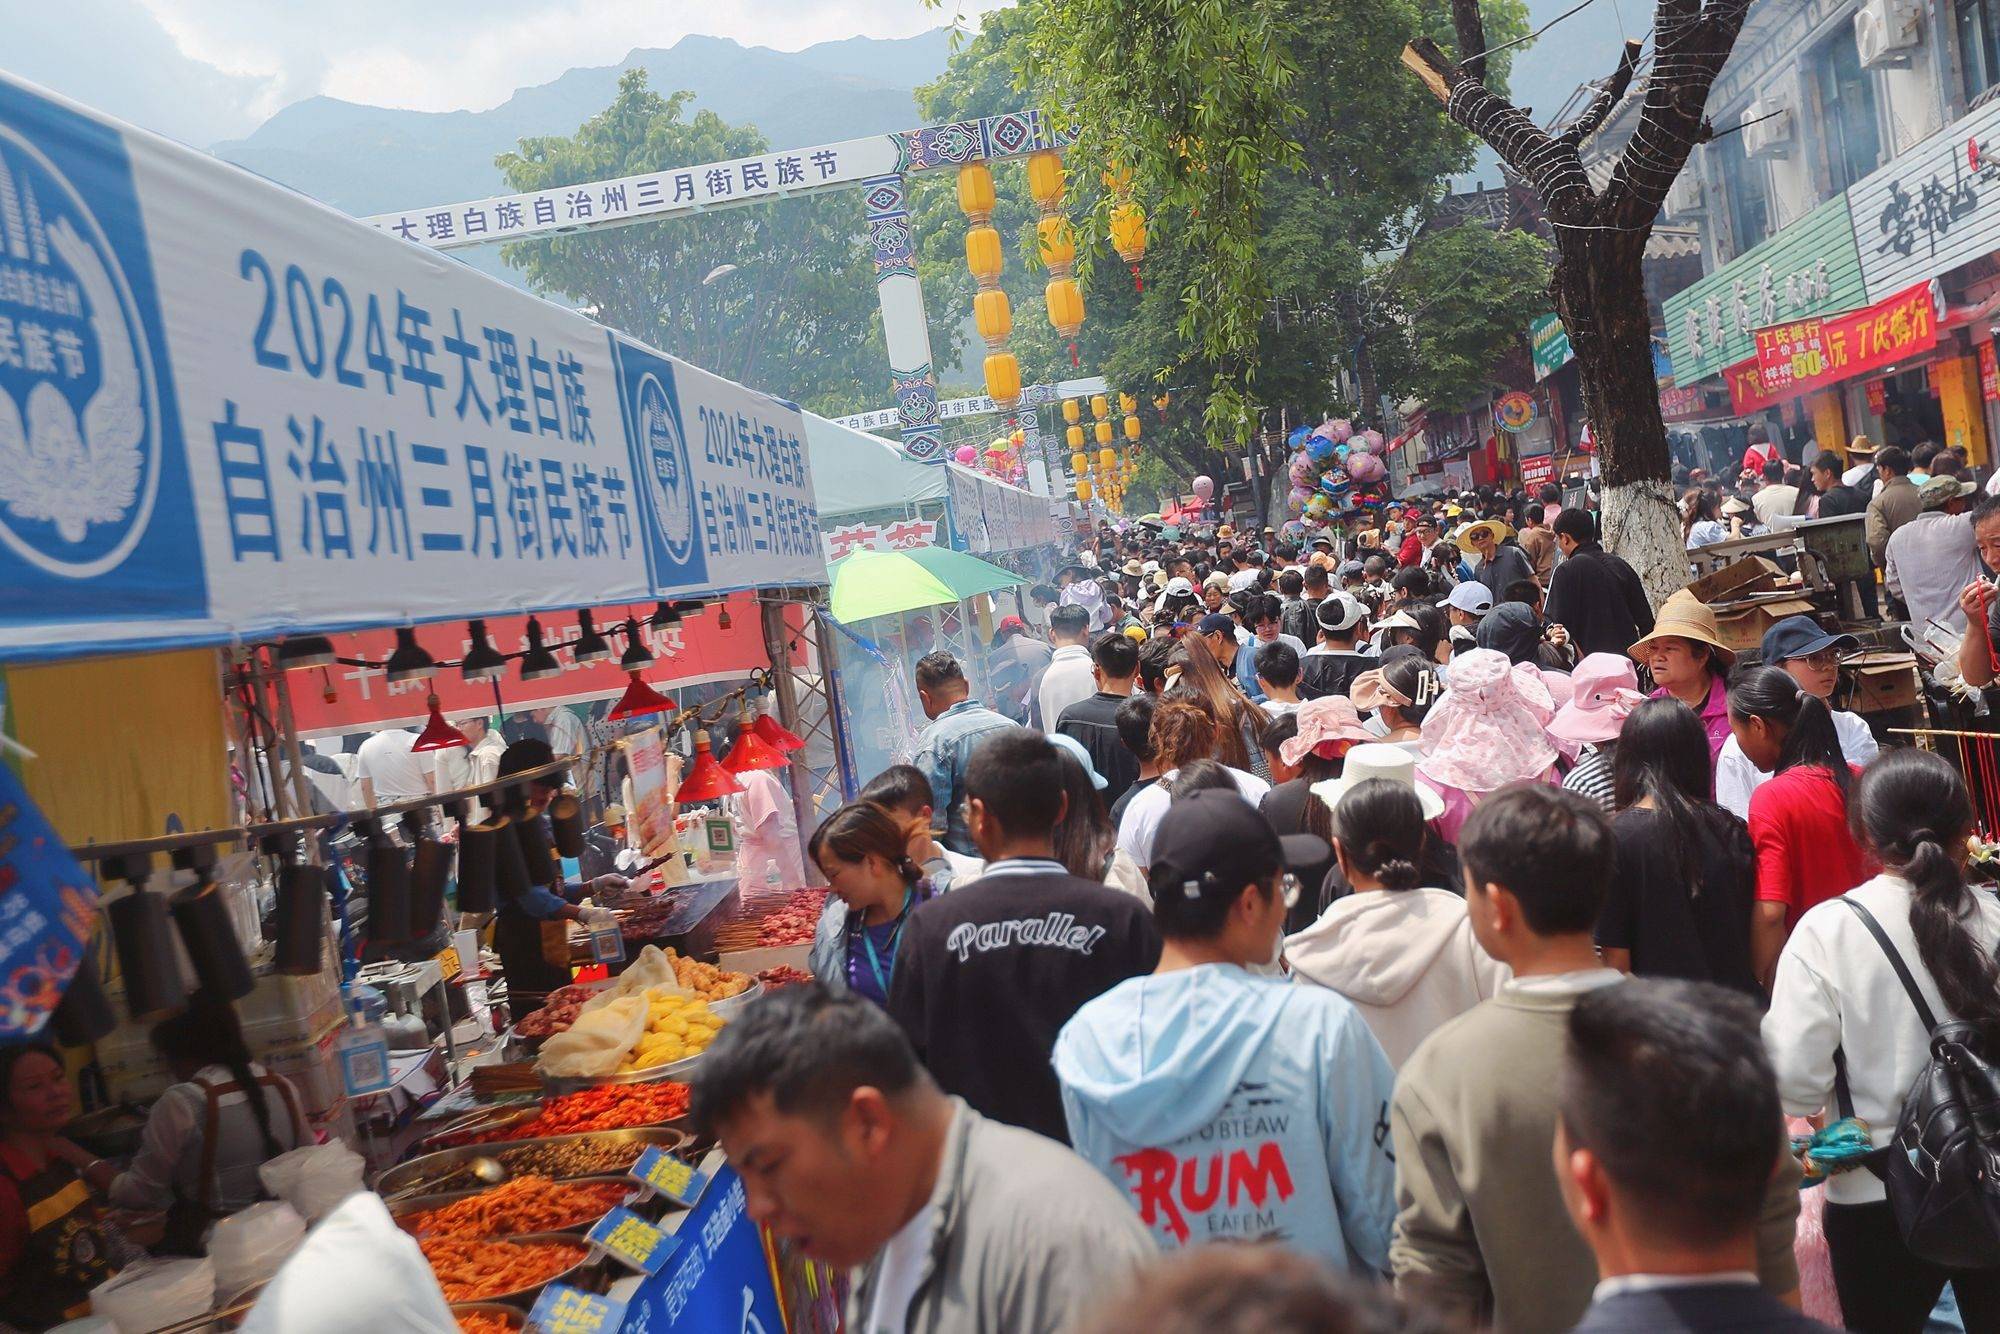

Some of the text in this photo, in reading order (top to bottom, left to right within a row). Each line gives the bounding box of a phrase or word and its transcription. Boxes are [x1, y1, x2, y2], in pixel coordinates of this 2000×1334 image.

[373, 149, 839, 244] 大理白族自治州三月街民族节
[240, 248, 597, 447] 2024年大理白族
[212, 398, 632, 563] 自治州三月街民族节
[700, 405, 806, 490] 2024年大理白族
[700, 480, 823, 559] 自治州三月街民族节
[947, 912, 1106, 963] Parallel
[1112, 1141, 1295, 1246] RUM
